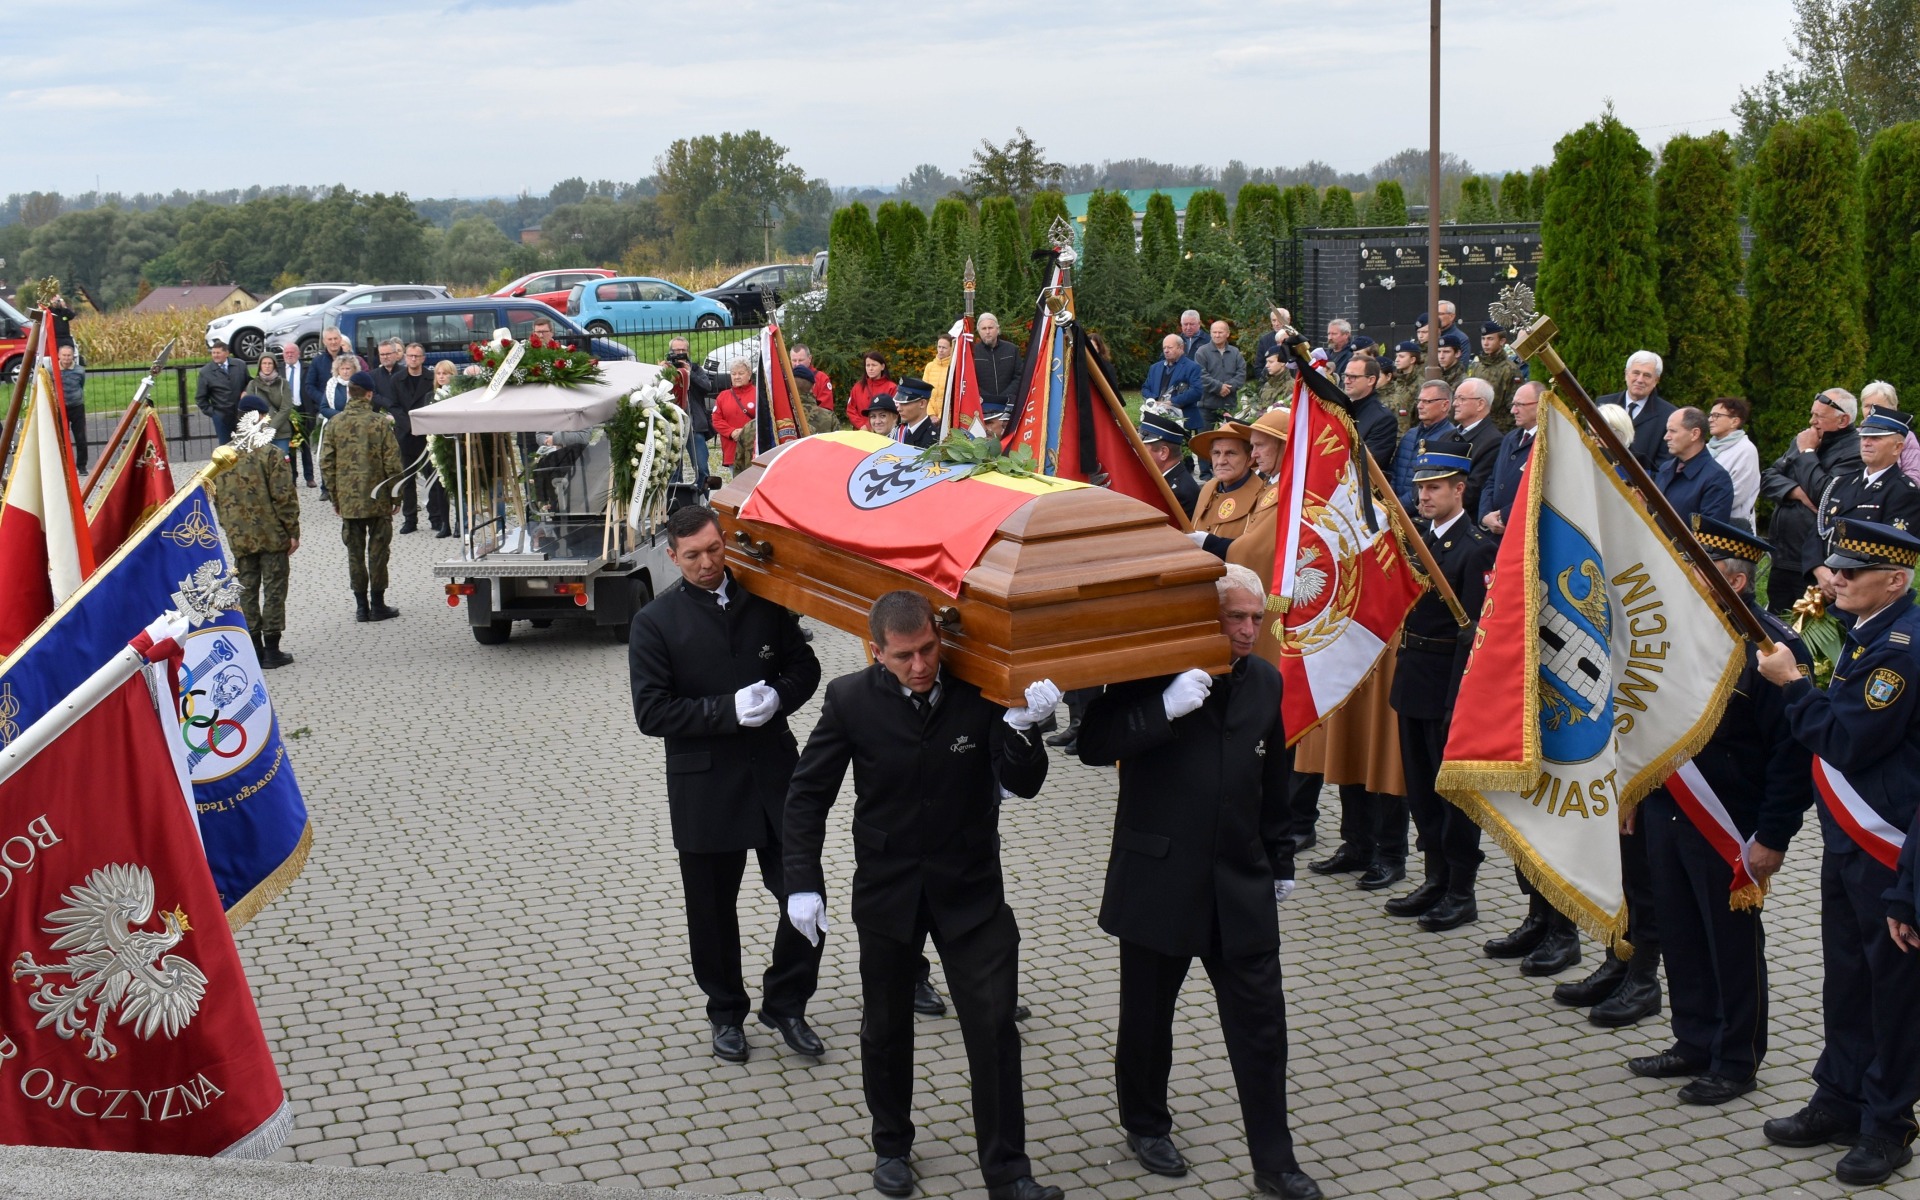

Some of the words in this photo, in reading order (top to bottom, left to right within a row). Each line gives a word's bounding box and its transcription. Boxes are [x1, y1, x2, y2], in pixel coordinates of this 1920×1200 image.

[1314, 424, 1345, 456] W
[174, 594, 202, 625] POLICJA
[1520, 768, 1618, 819] MIAST
[1611, 562, 1671, 754] ŚWIĘCIM
[950, 743, 977, 754] Korona
[196, 800, 228, 814] Tech
[228, 797, 235, 809] i
[20, 1068, 226, 1122] OJCZYZNA
